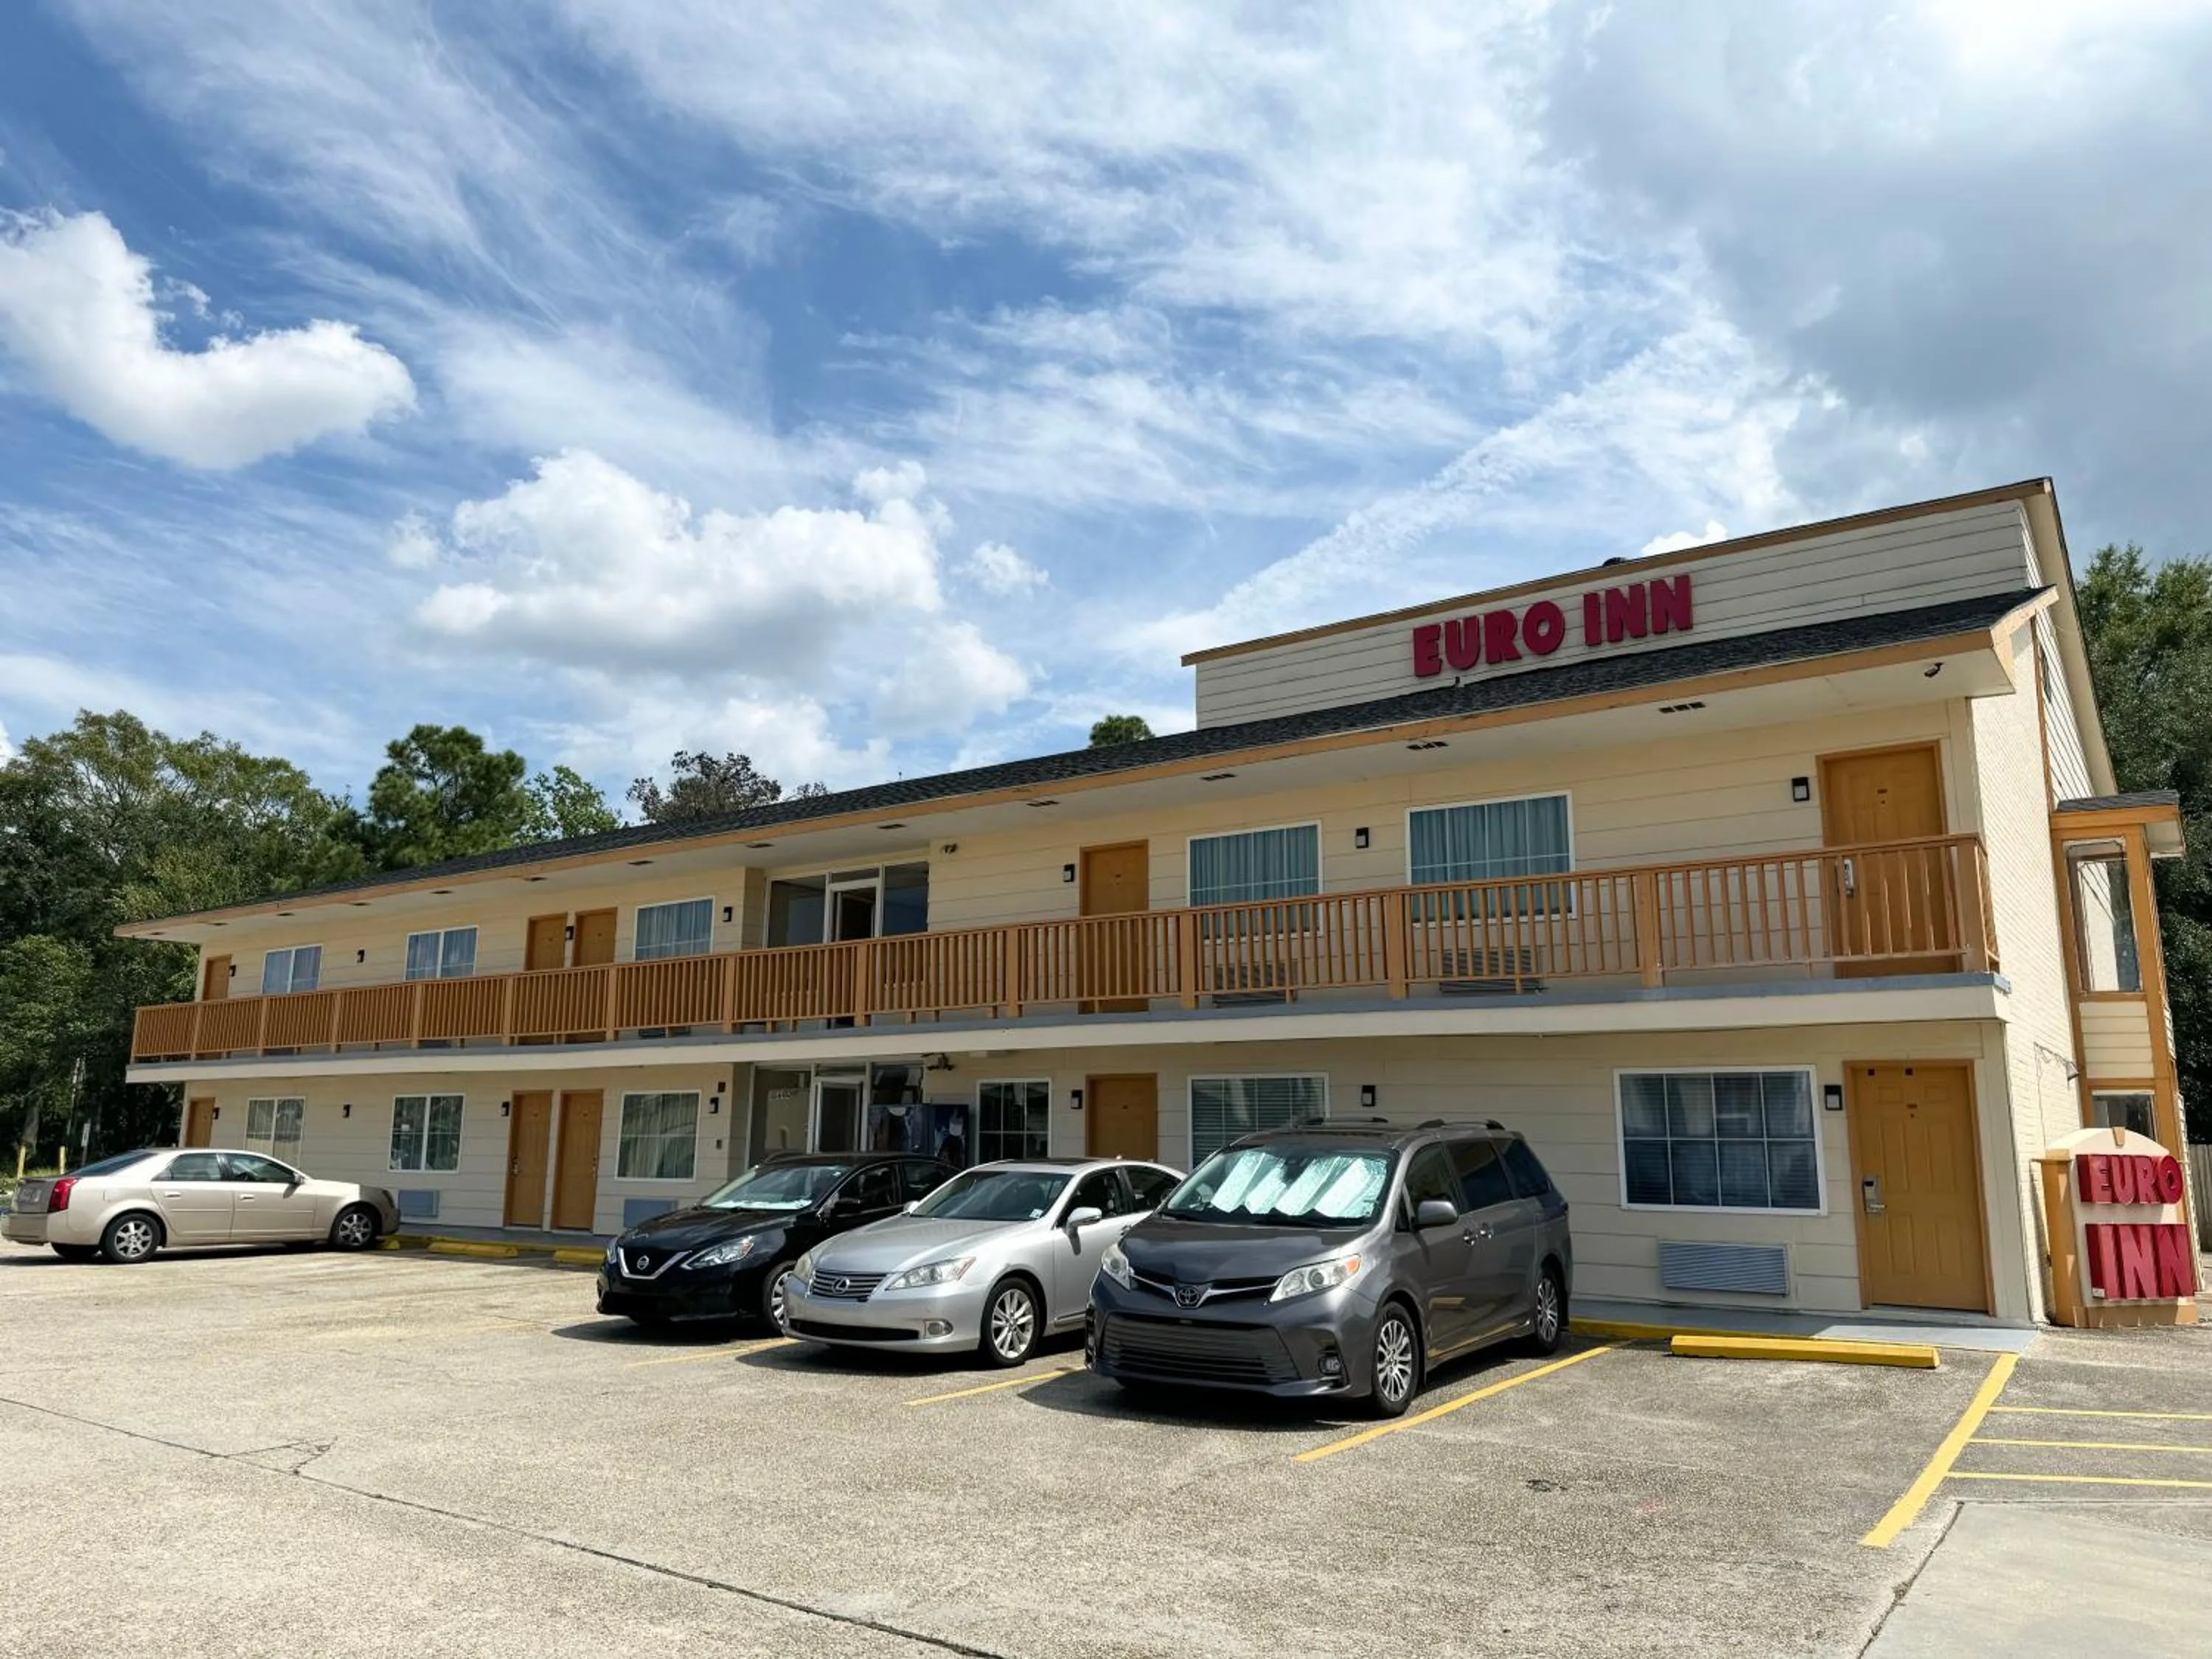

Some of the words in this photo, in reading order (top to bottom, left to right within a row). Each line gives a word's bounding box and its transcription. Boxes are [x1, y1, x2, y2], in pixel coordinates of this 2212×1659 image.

[1413, 600, 1565, 677] EURO
[1583, 574, 1693, 647] INN
[2084, 1155, 2183, 1204] EURO
[2094, 1224, 2195, 1298] INN
